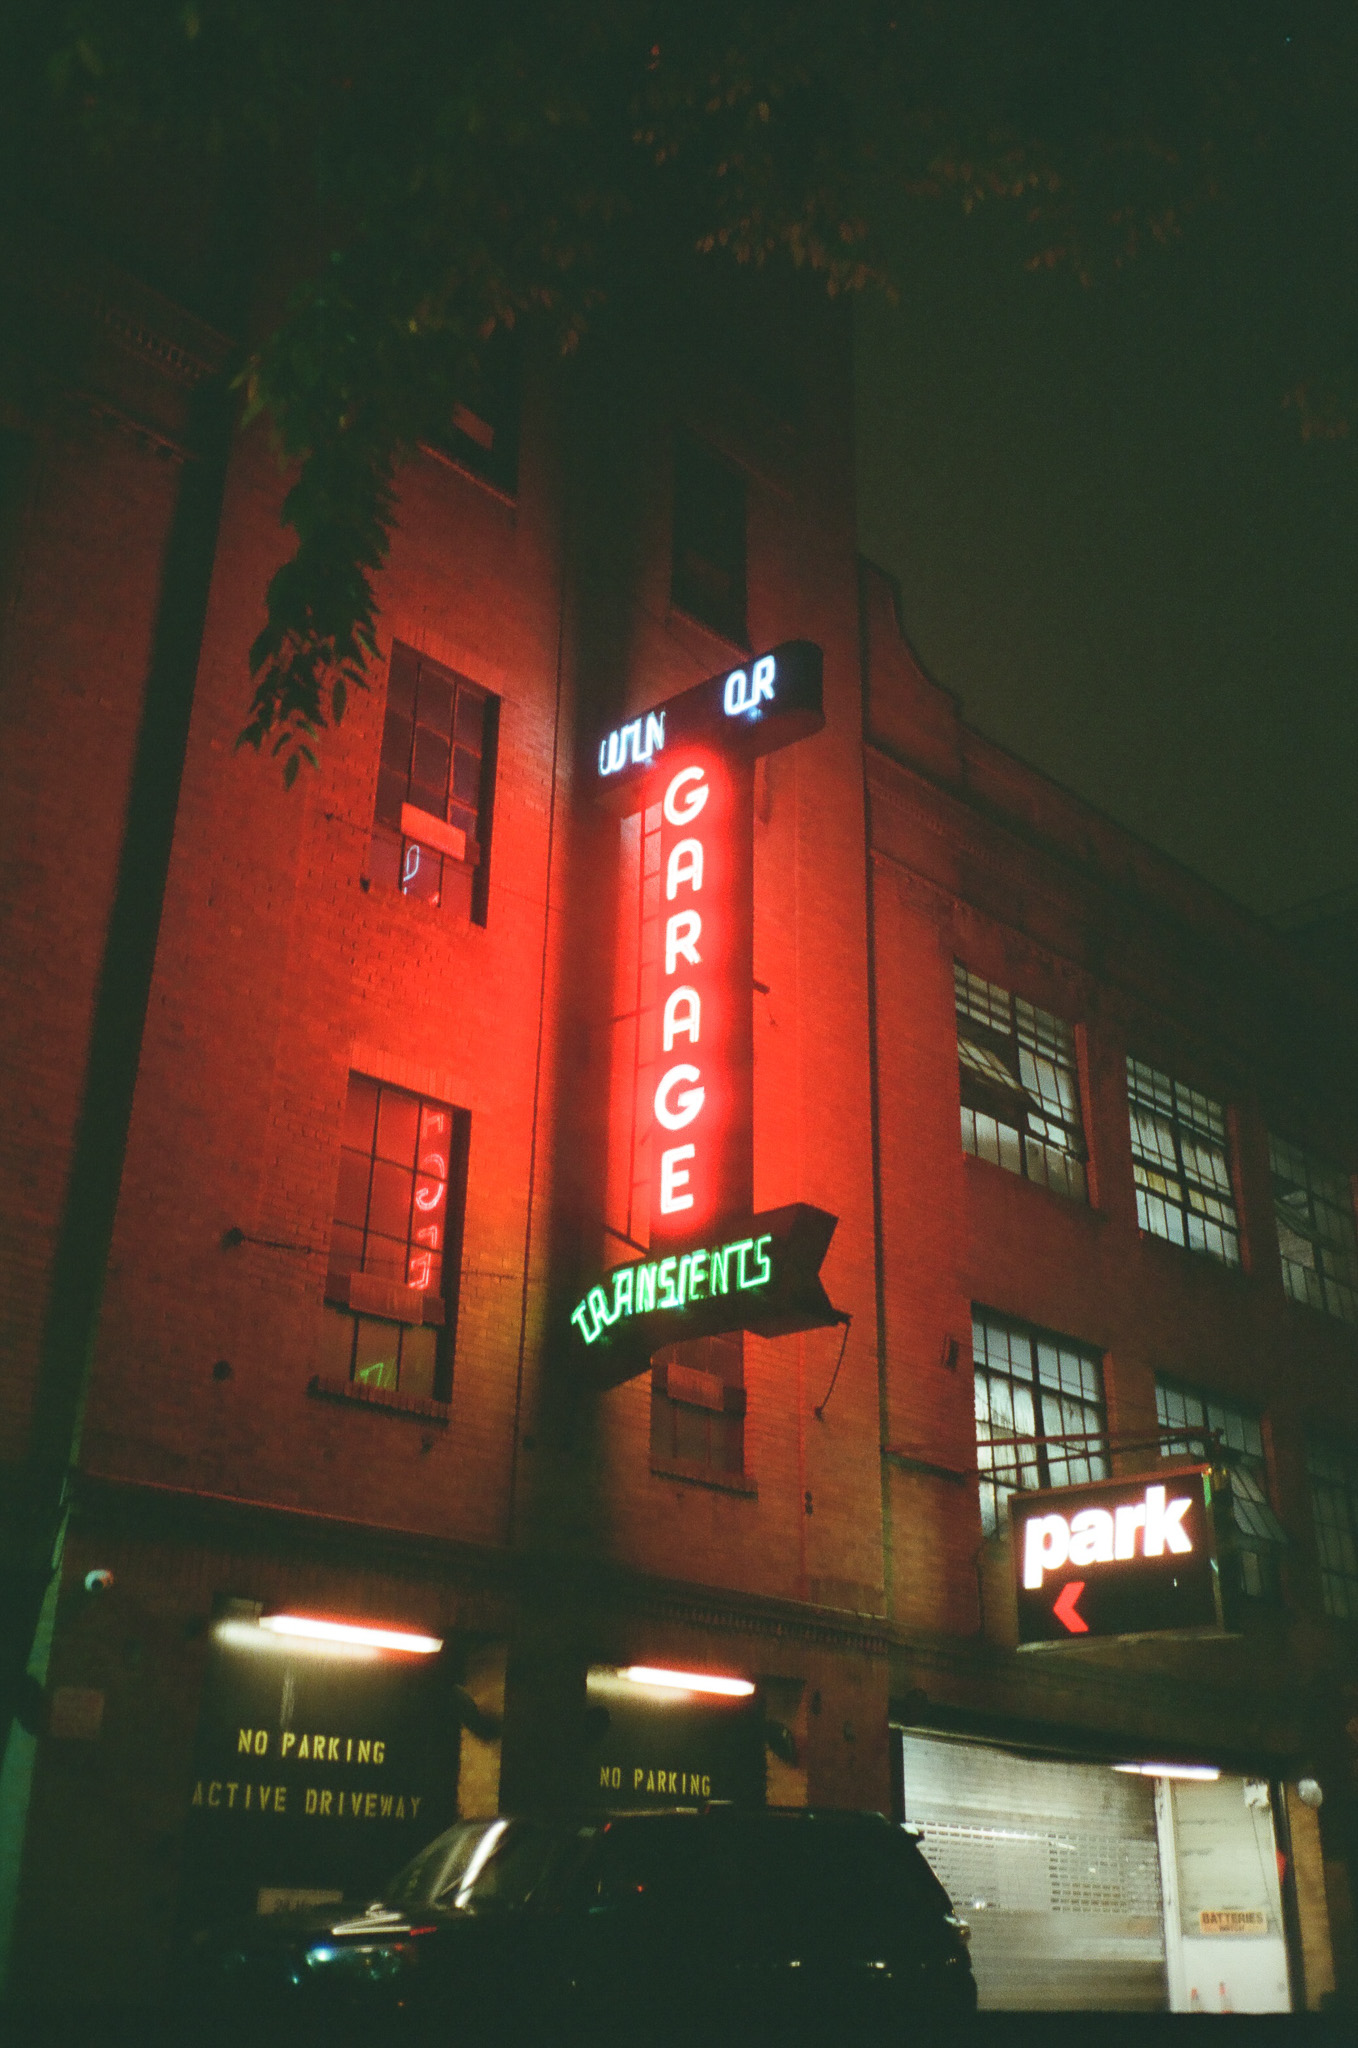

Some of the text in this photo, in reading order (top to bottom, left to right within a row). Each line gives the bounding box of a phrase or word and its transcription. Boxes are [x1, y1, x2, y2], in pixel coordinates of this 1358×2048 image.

[653, 765, 710, 1216] GARAGE
[570, 1233, 773, 1345] TRANSIENTS
[1023, 1484, 1193, 1590] park
[238, 1728, 385, 1764] NO PARKING
[192, 1781, 420, 1818] ACTIVE DRIVEWAY
[600, 1766, 710, 1797] NO PARKING
[1202, 1912, 1263, 1925] BATTERIES
